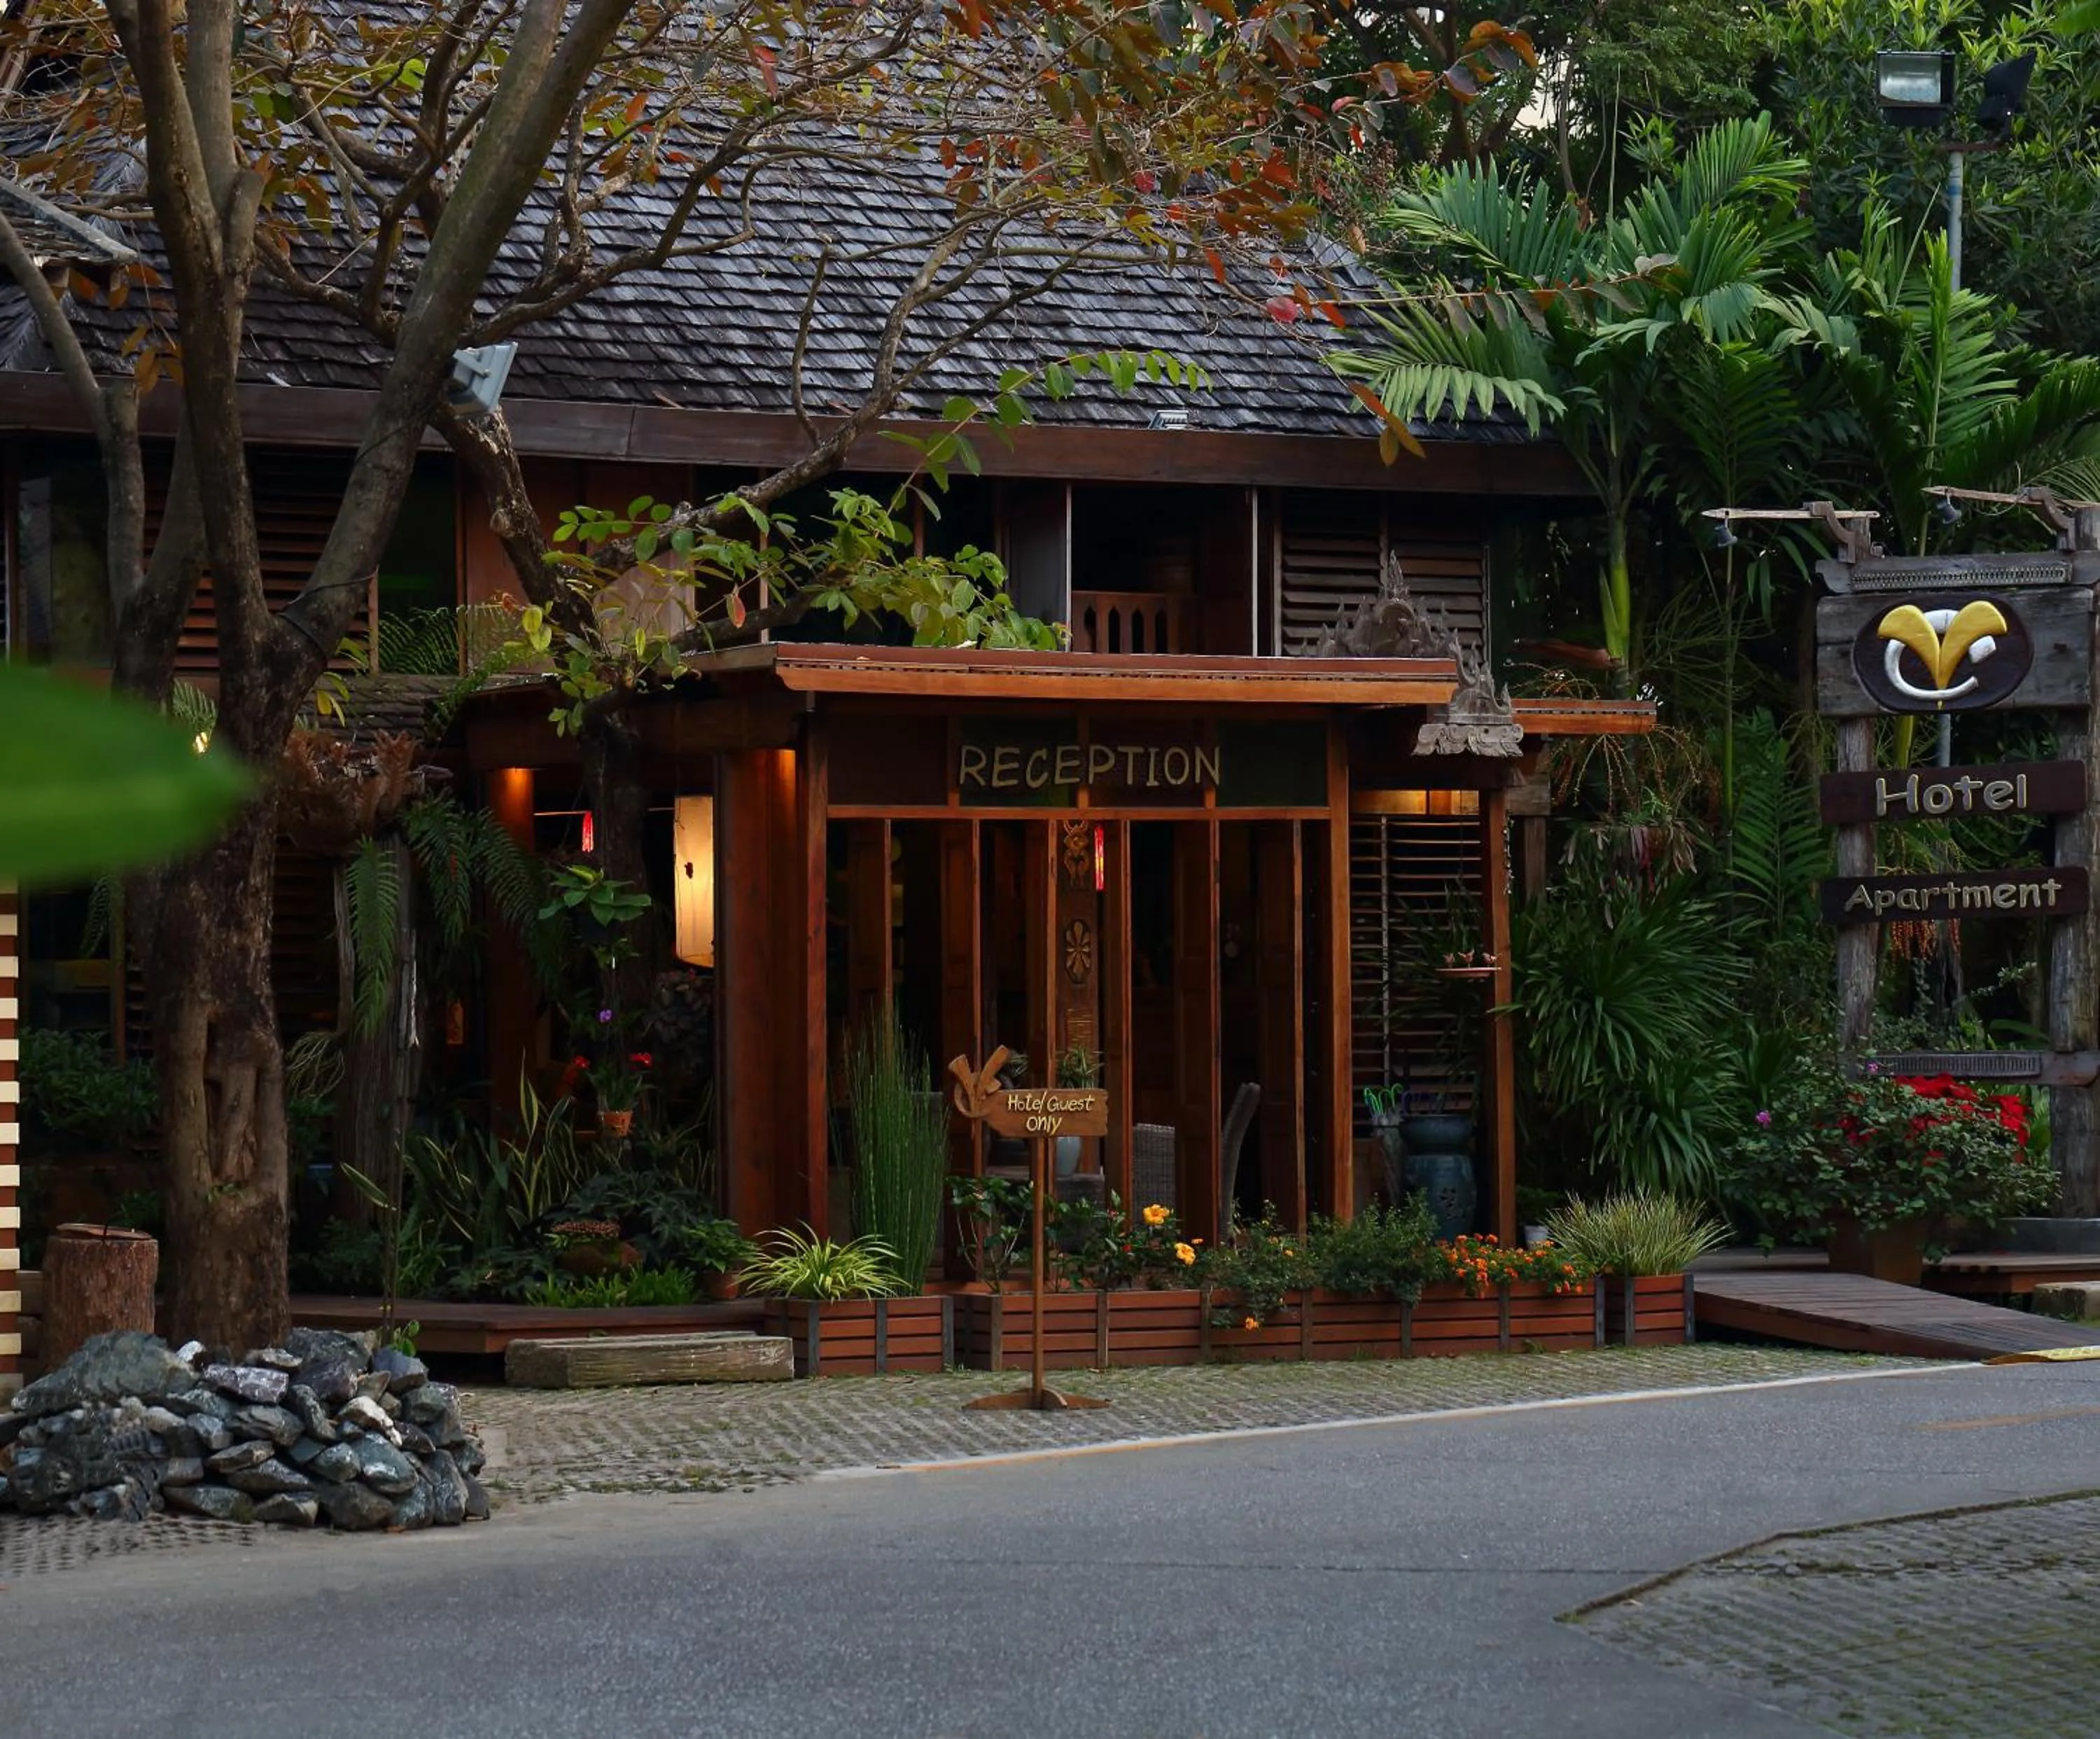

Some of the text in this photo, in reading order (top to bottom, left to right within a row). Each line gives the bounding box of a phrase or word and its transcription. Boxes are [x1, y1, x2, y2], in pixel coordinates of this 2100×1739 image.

[959, 744, 1222, 789] RECEPTION
[1875, 774, 2027, 817] Hotel
[1844, 878, 2062, 917] Apartment
[1008, 1091, 1095, 1114] Hotel Guest
